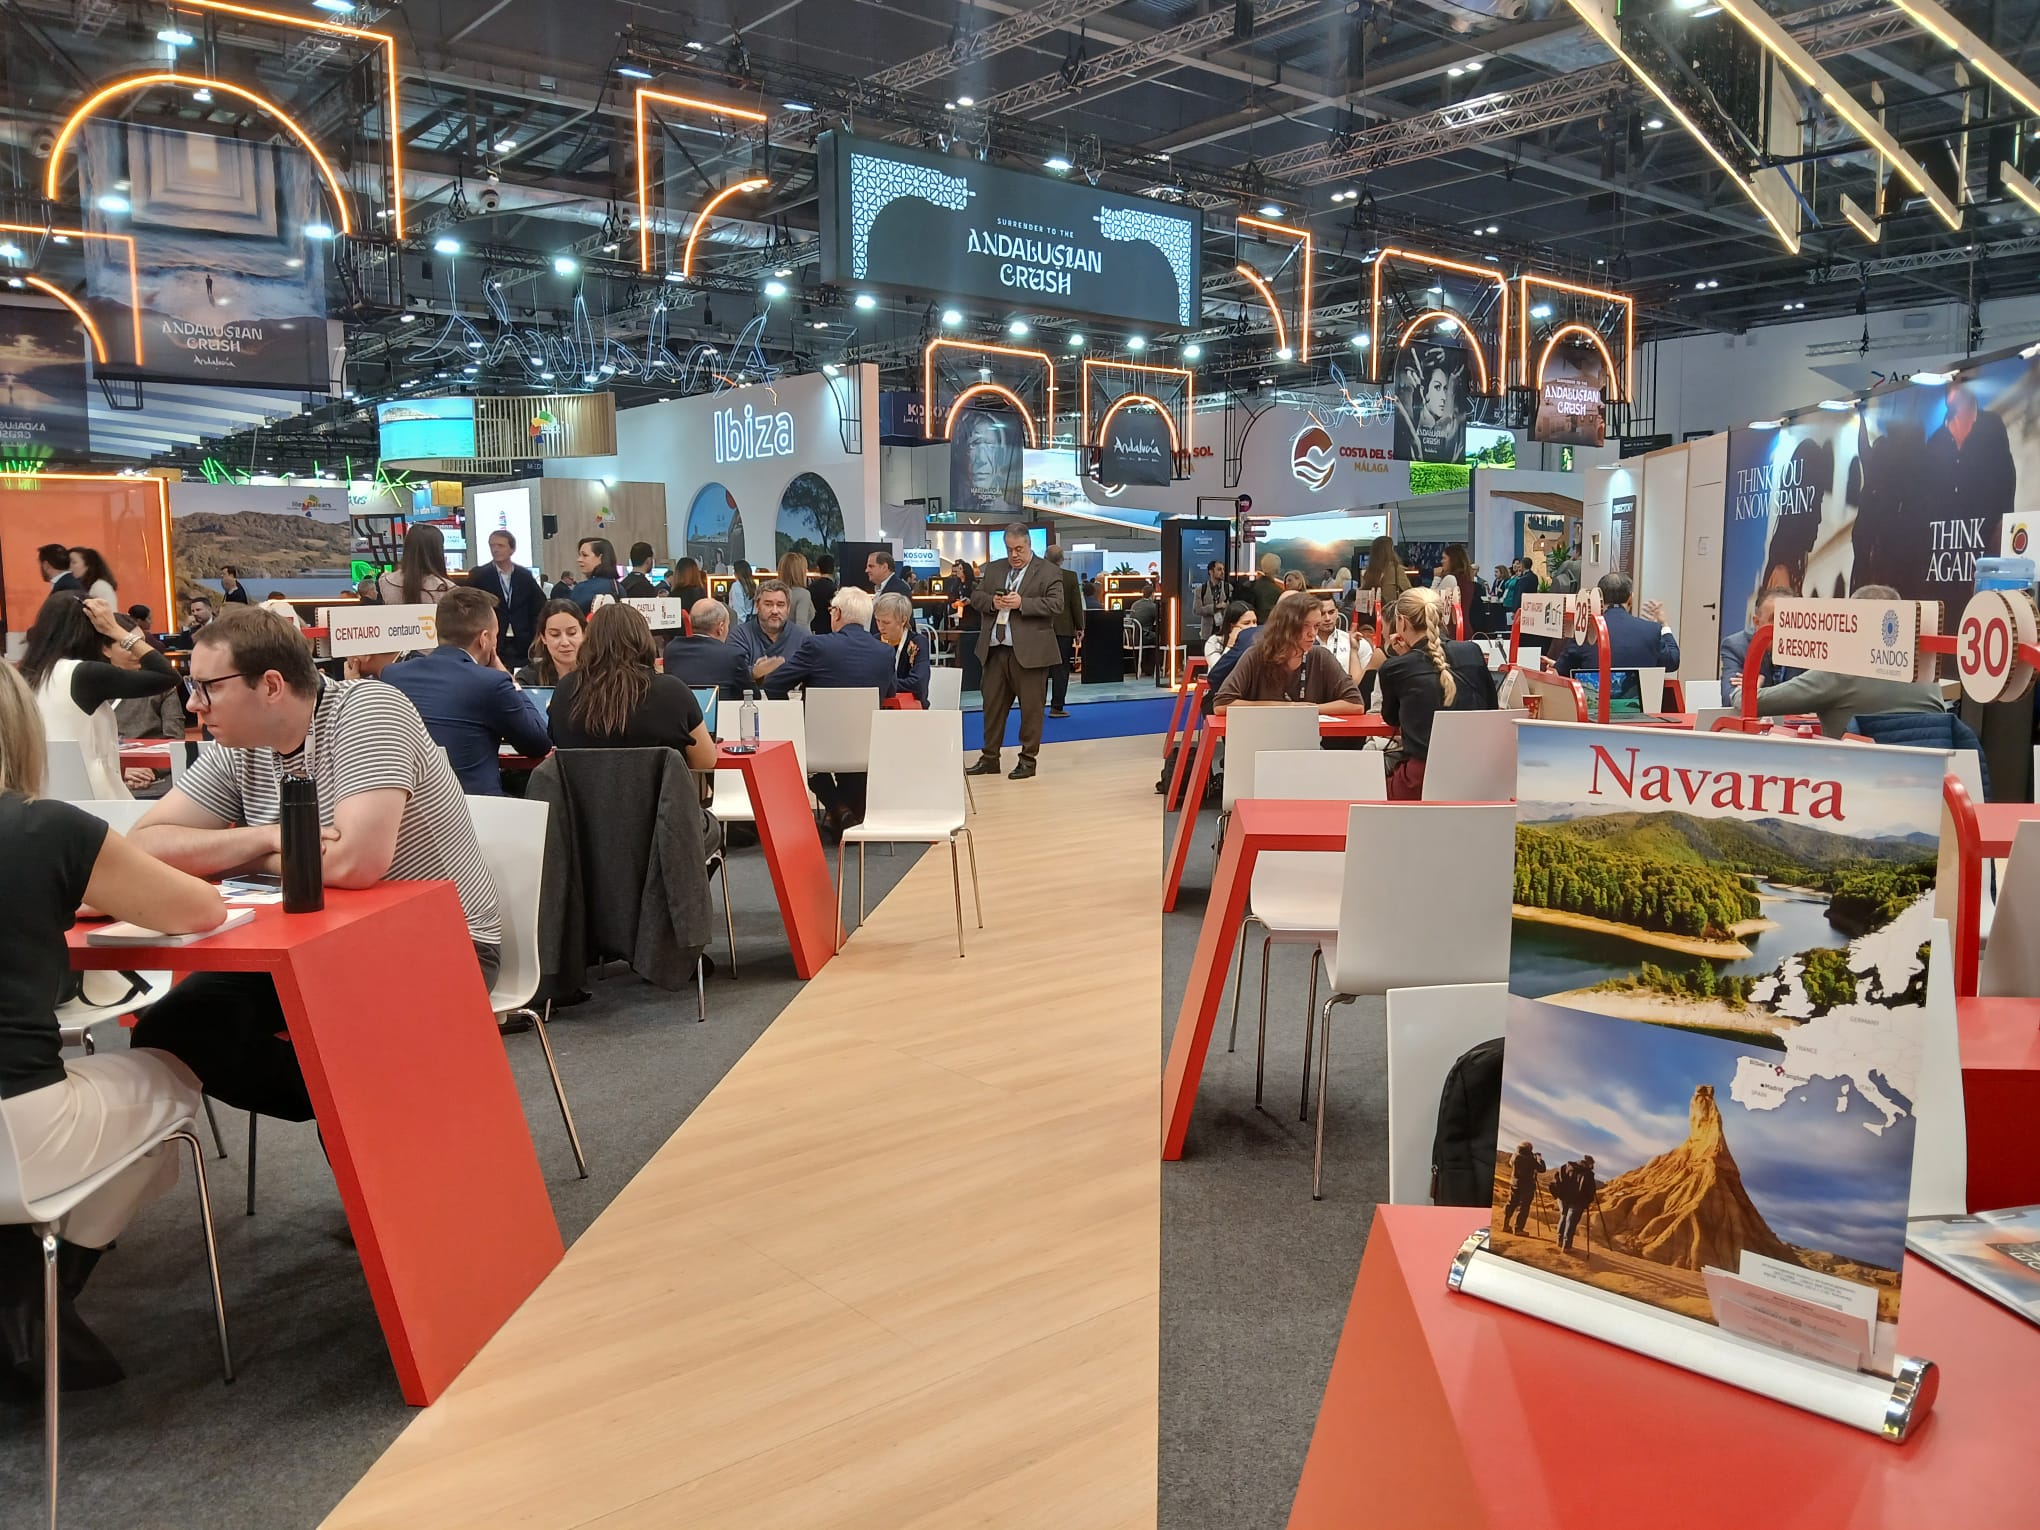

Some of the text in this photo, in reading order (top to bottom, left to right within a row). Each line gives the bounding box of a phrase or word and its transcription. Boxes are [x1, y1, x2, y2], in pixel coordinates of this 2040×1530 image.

[997, 218, 1075, 238] SURRENDER TO THE
[967, 228, 1102, 273] ANDALUSIAN
[1000, 263, 1071, 295] CRUSH
[162, 320, 263, 341] ANDALUSIAN
[186, 337, 241, 353] CRUSH
[1545, 385, 1600, 403] ANDALUSIAN
[1557, 401, 1586, 416] CRUSH
[714, 404, 794, 463] Ibiza
[1193, 446, 1214, 457] SOL
[1340, 446, 1368, 459] COSTA
[1370, 447, 1386, 459] DEL
[1354, 461, 1388, 473] MÁLAGA
[1737, 465, 1774, 494] THINK
[1736, 486, 1815, 520] KNOW SPAIN?
[1929, 517, 1985, 550] THINK
[1575, 602, 1587, 632] 28
[1779, 611, 1858, 633] SANDOS HOTELS
[335, 626, 380, 641] CENTAURO
[387, 624, 420, 636] centauro
[1778, 638, 1828, 660] & RESORTS
[1961, 617, 2009, 677] 30
[1870, 649, 1909, 668] SANDOS
[1588, 744, 1846, 821] Navarra
[1850, 1016, 1879, 1026] GERMANY
[1795, 1045, 1817, 1055] FRANCE
[1751, 1089, 1767, 1098] SPAIN
[1764, 1083, 1784, 1093] Madrid
[1859, 1083, 1876, 1093] ITALY
